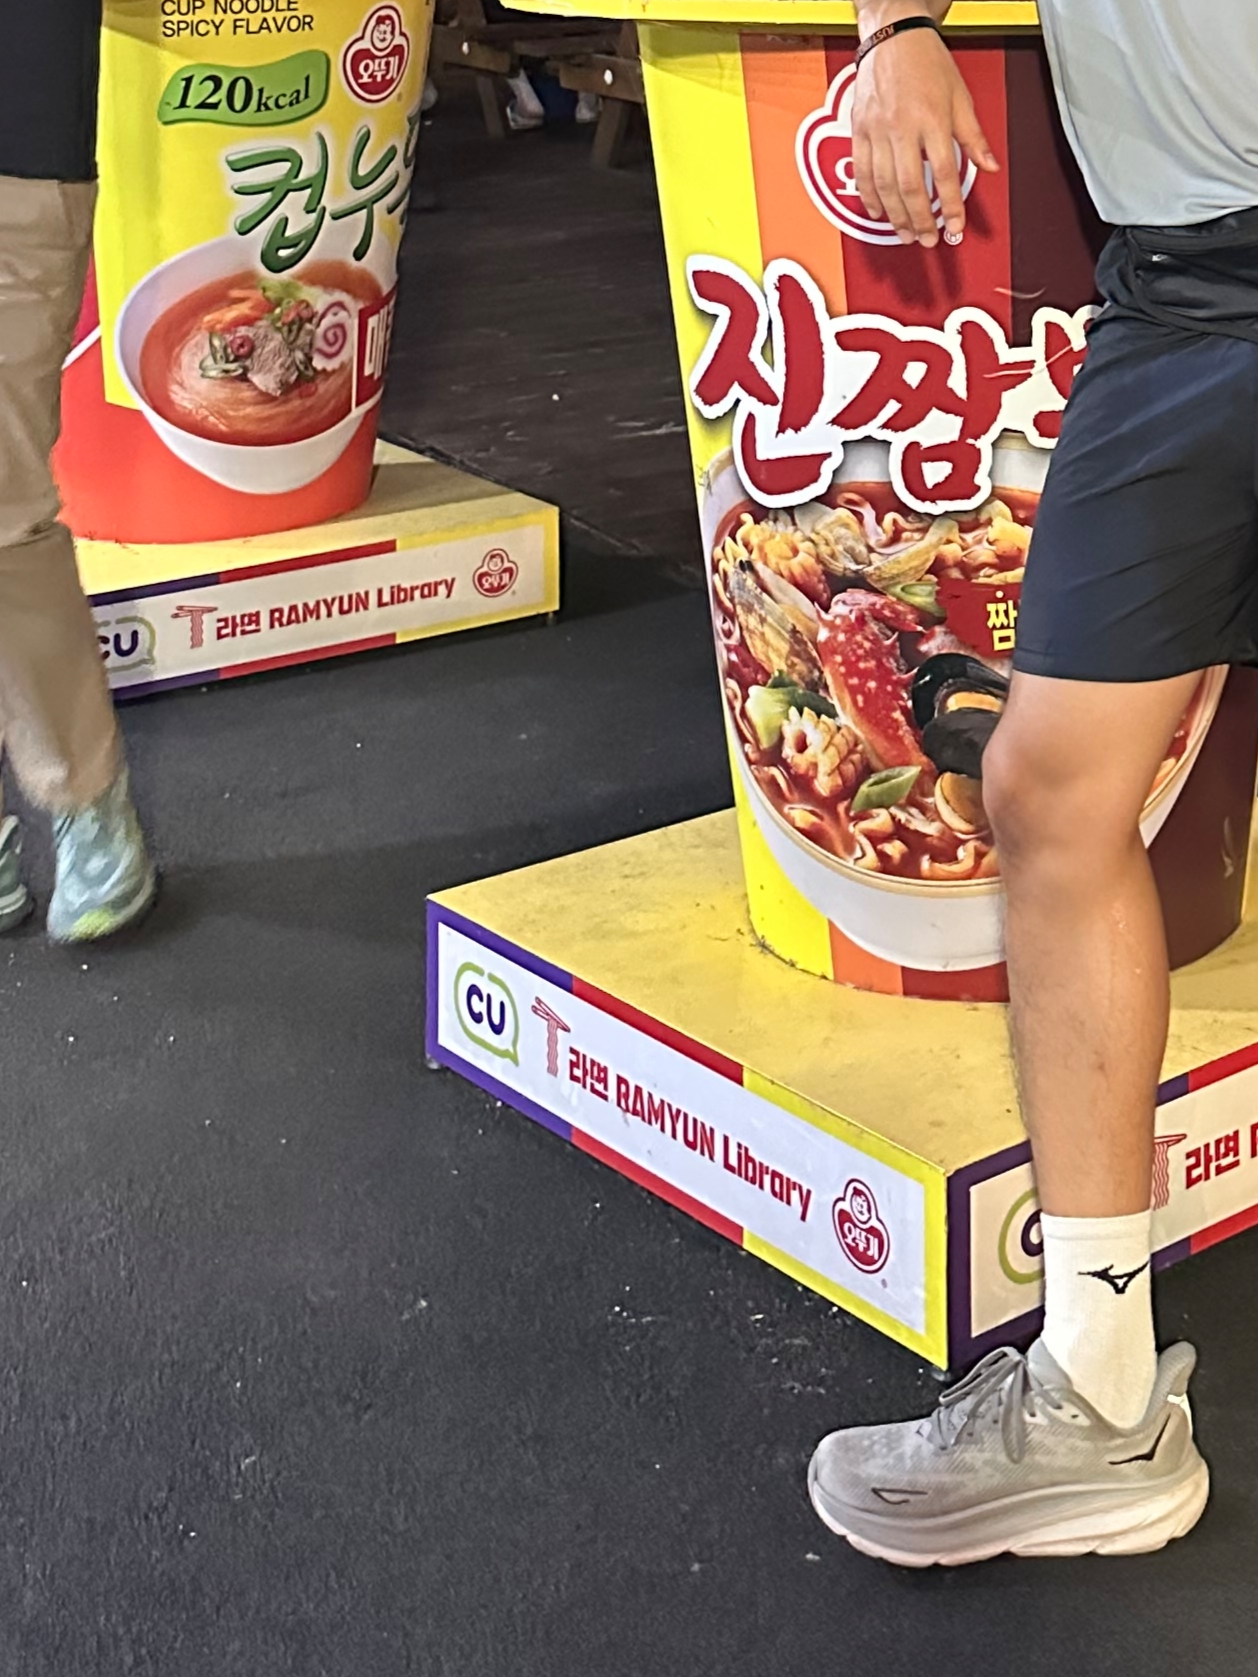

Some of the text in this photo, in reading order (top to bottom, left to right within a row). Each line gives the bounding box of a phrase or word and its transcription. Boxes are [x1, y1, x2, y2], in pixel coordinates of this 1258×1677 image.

[162, 14, 314, 37] SPICY FLAVOR
[172, 73, 310, 114] 120kcal
[357, 54, 400, 84] 오뚜기
[215, 610, 261, 641] 라면
[269, 590, 370, 629] RAMYUN
[376, 577, 456, 609] Library
[986, 600, 1018, 652] 짬
[465, 983, 506, 1036] CU
[568, 1046, 813, 1223] 라면 RAMYUN Library
[1184, 1129, 1240, 1190] 라면
[842, 1221, 880, 1261] 오뚜기
